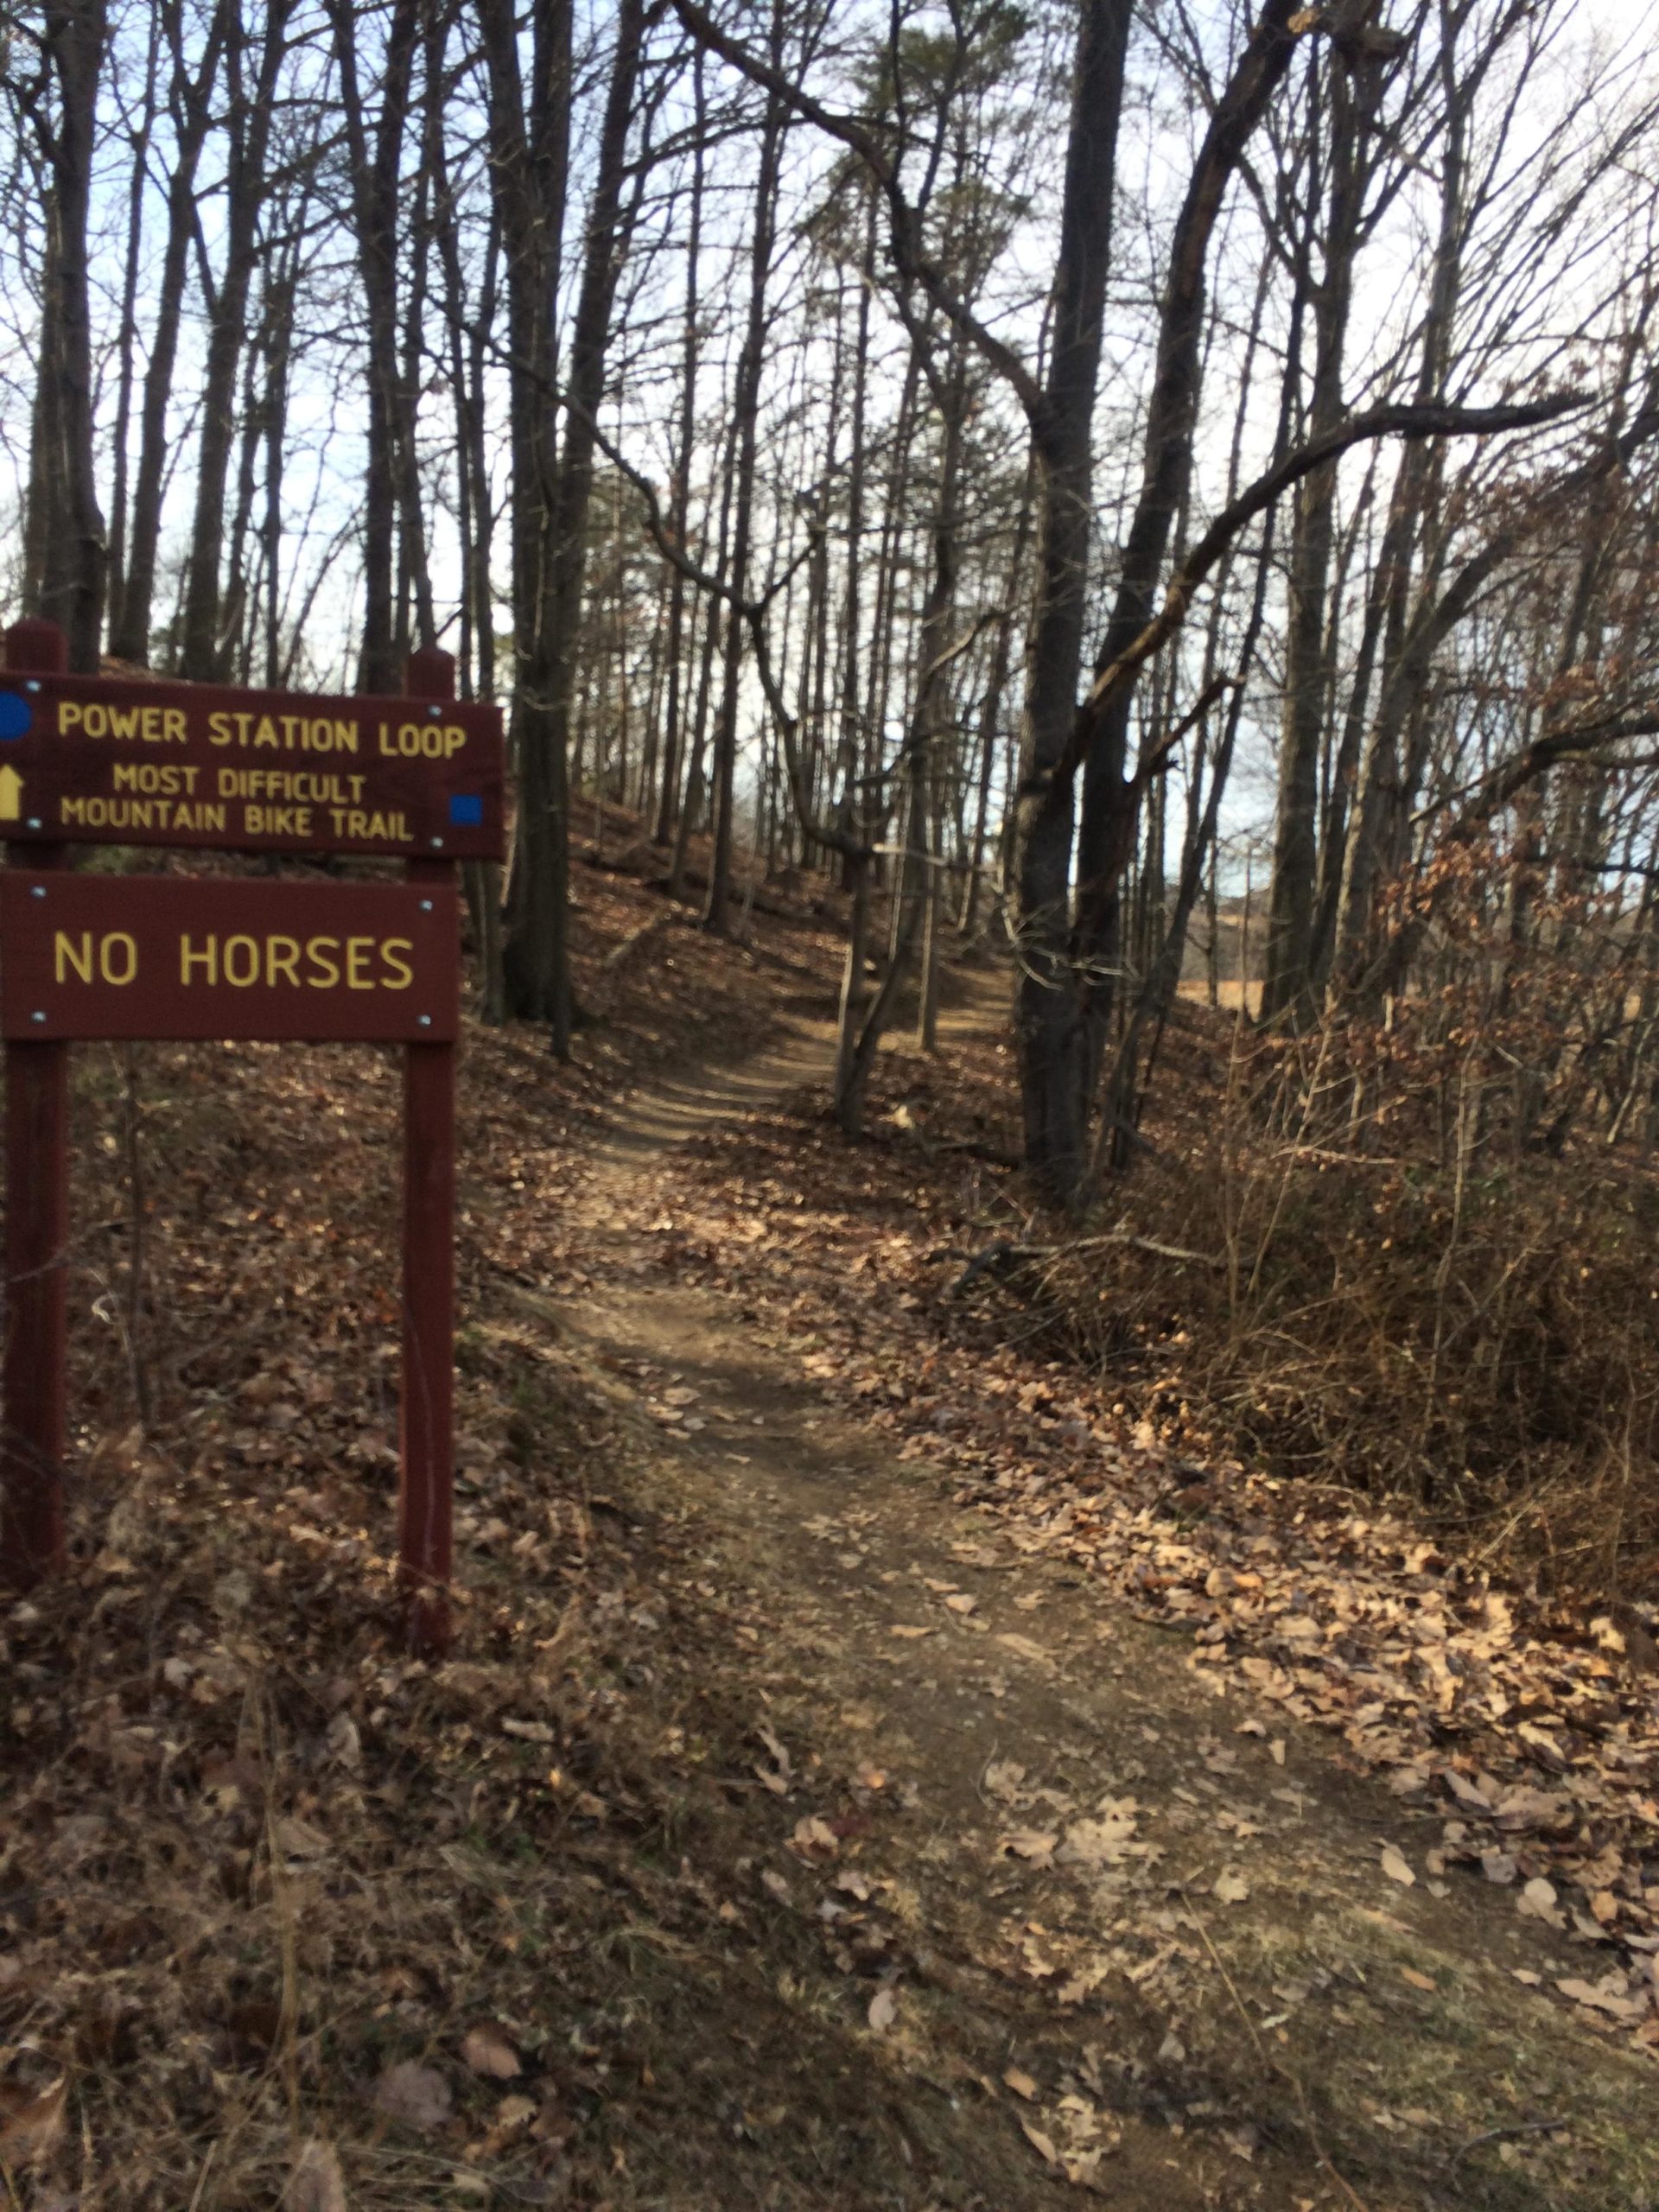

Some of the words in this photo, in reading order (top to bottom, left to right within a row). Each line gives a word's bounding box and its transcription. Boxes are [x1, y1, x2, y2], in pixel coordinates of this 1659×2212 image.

[58, 702, 187, 742] POWER
[207, 711, 359, 753] STATION
[378, 722, 467, 758] LOOP
[113, 763, 200, 794] MOST
[218, 768, 365, 803] DIFFICULT
[61, 798, 226, 832] MOUNTAIN
[245, 804, 312, 836] BIKE
[328, 809, 414, 841] TRAIL
[54, 931, 137, 985] NO
[180, 934, 415, 990] HORSES
